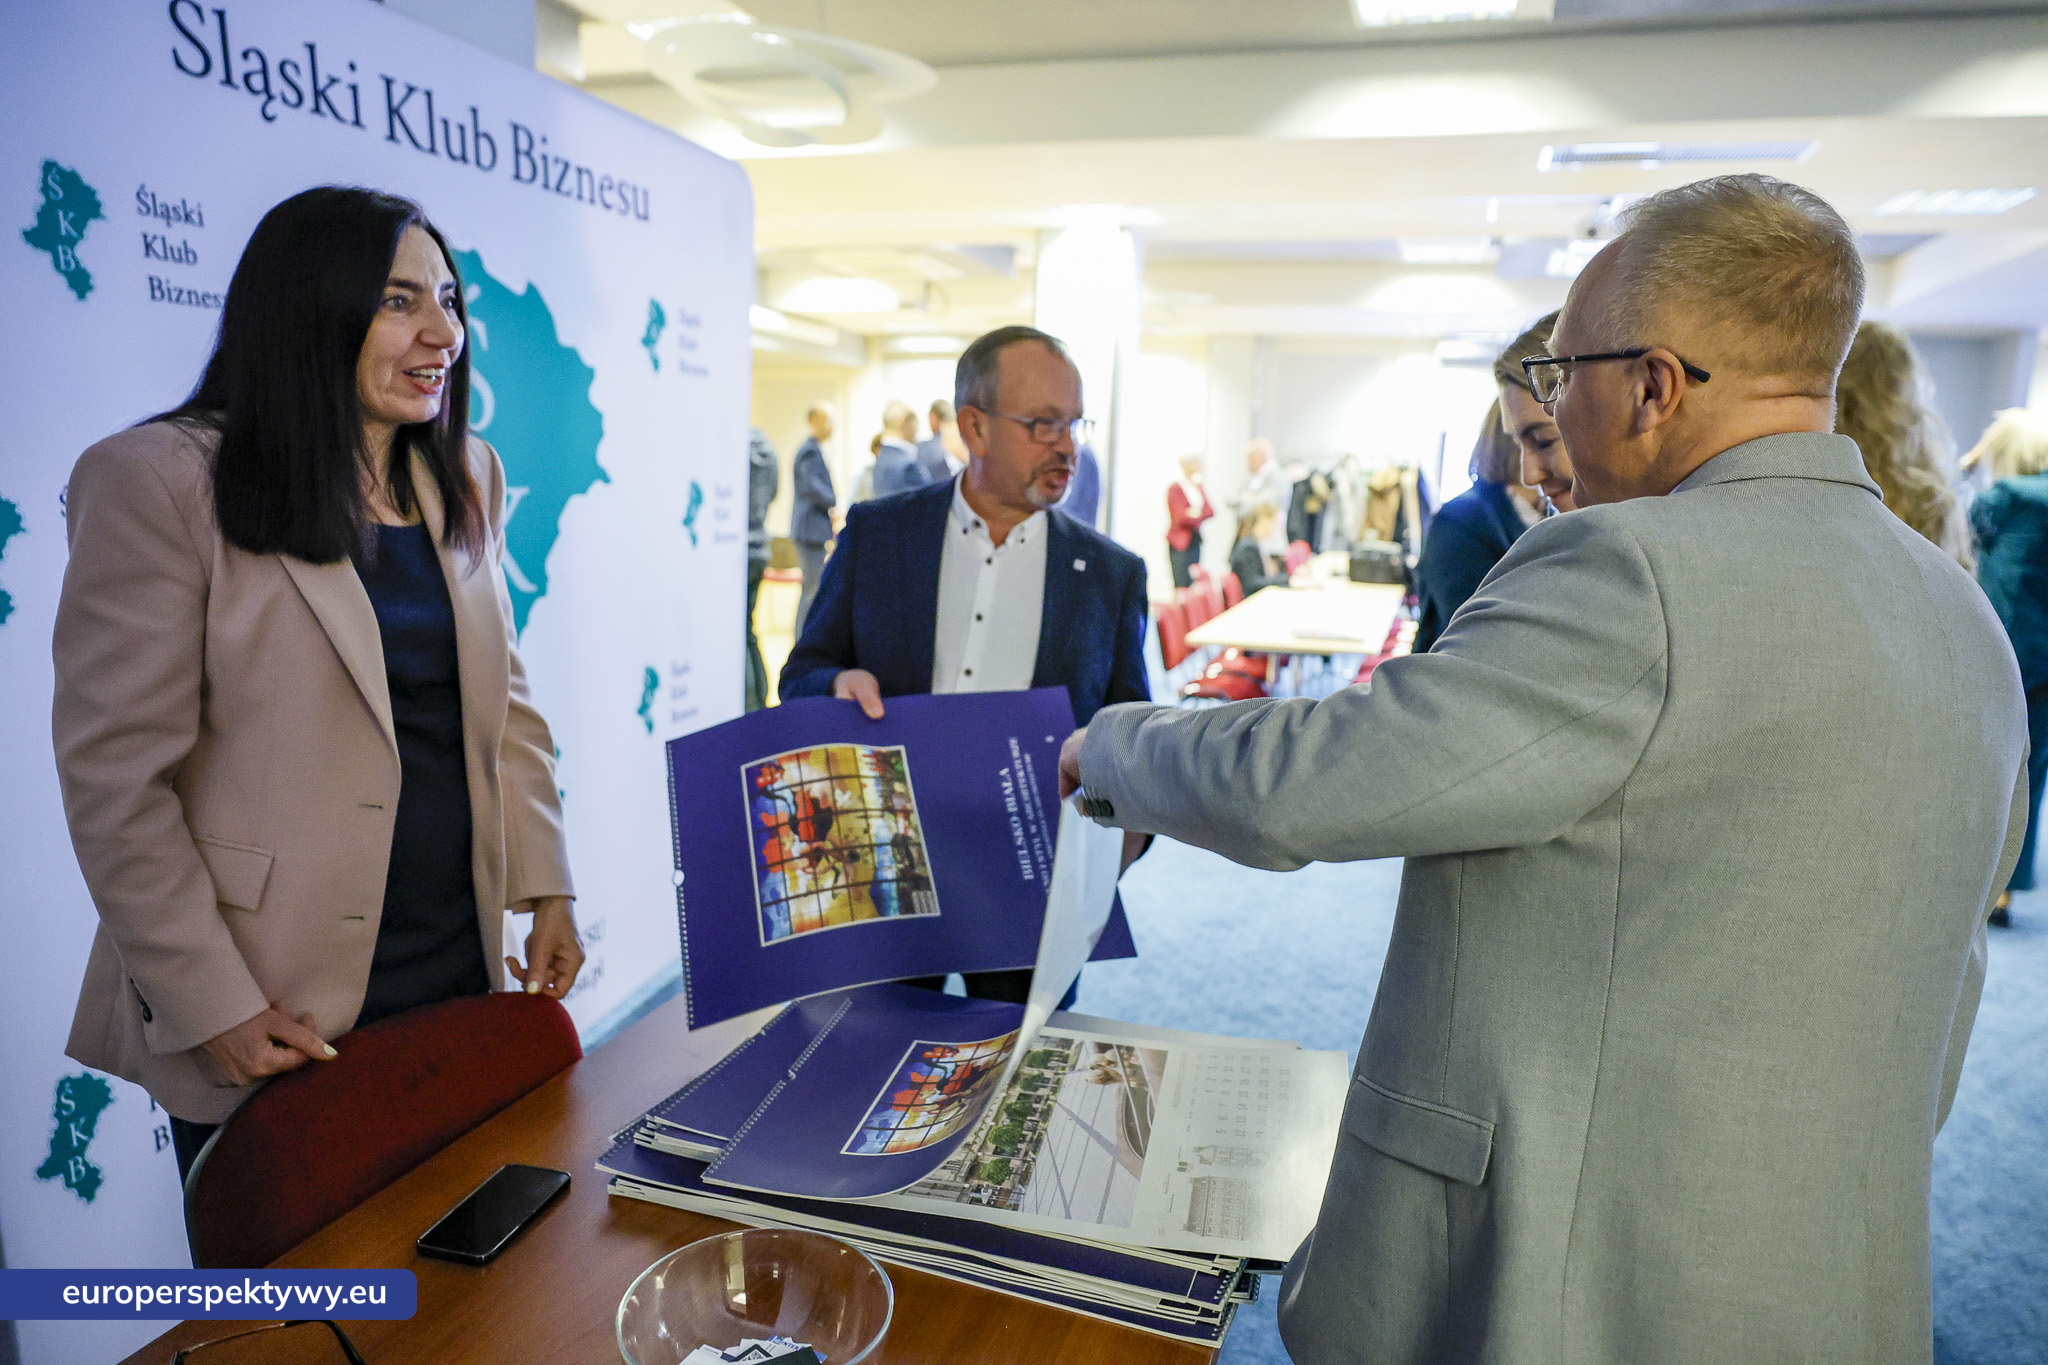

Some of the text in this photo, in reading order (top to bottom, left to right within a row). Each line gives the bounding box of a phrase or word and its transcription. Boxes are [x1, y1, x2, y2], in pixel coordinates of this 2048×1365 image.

[379, 73, 498, 171] Klub
[508, 119, 650, 222] Biznesu
[136, 183, 204, 228] Śląski
[142, 231, 198, 266] Klub
[149, 274, 223, 310] Biznes
